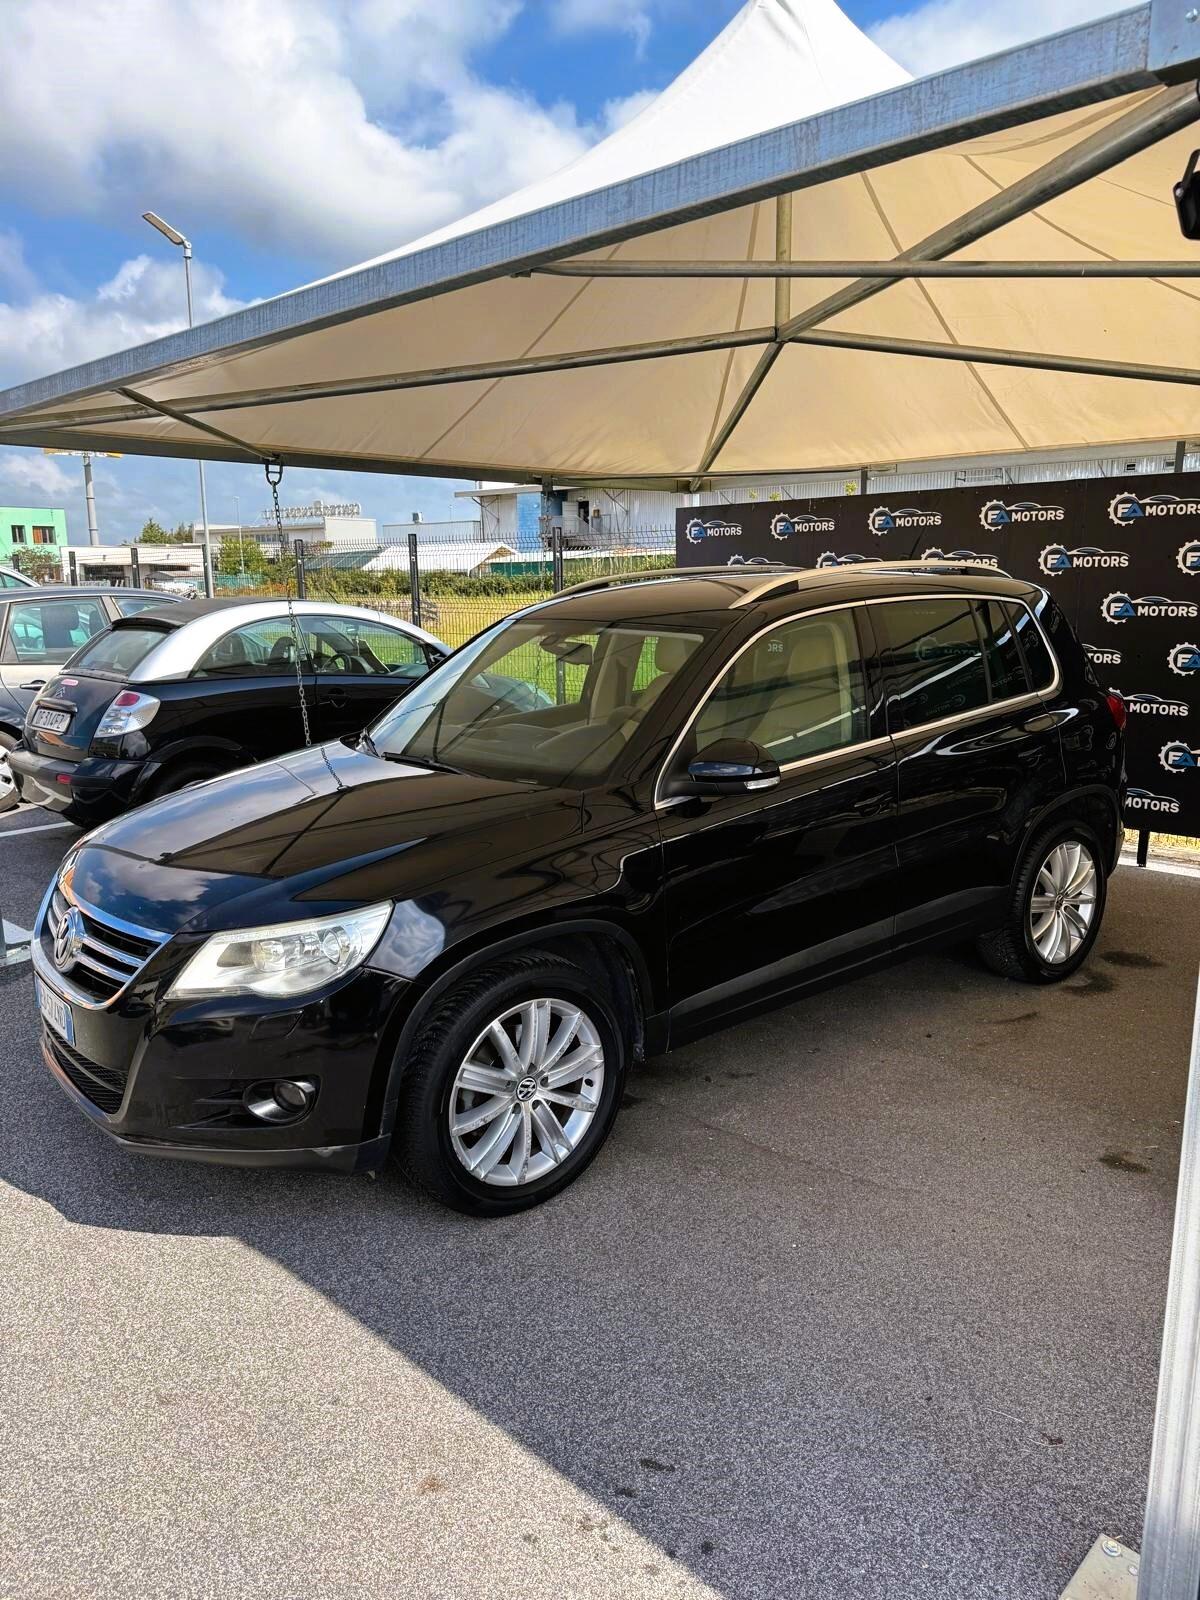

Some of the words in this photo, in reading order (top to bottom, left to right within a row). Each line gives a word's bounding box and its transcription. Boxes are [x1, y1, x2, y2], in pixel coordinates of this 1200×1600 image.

[987, 509, 1010, 523] FA
[1011, 509, 1065, 522] MOTORS
[1117, 502, 1144, 518] FA
[776, 521, 795, 535] FA
[794, 520, 835, 533] MOTORS
[874, 515, 895, 529] FA
[895, 515, 942, 528] MOTORS
[691, 526, 706, 539] FA
[706, 526, 743, 537] MOTORS
[1046, 554, 1072, 569] FA
[1072, 555, 1129, 568] MOTORS
[1109, 602, 1136, 617] FA
[1137, 605, 1198, 617] MOTORS
[1129, 702, 1189, 717] MOTORS
[1168, 751, 1197, 767] FA
